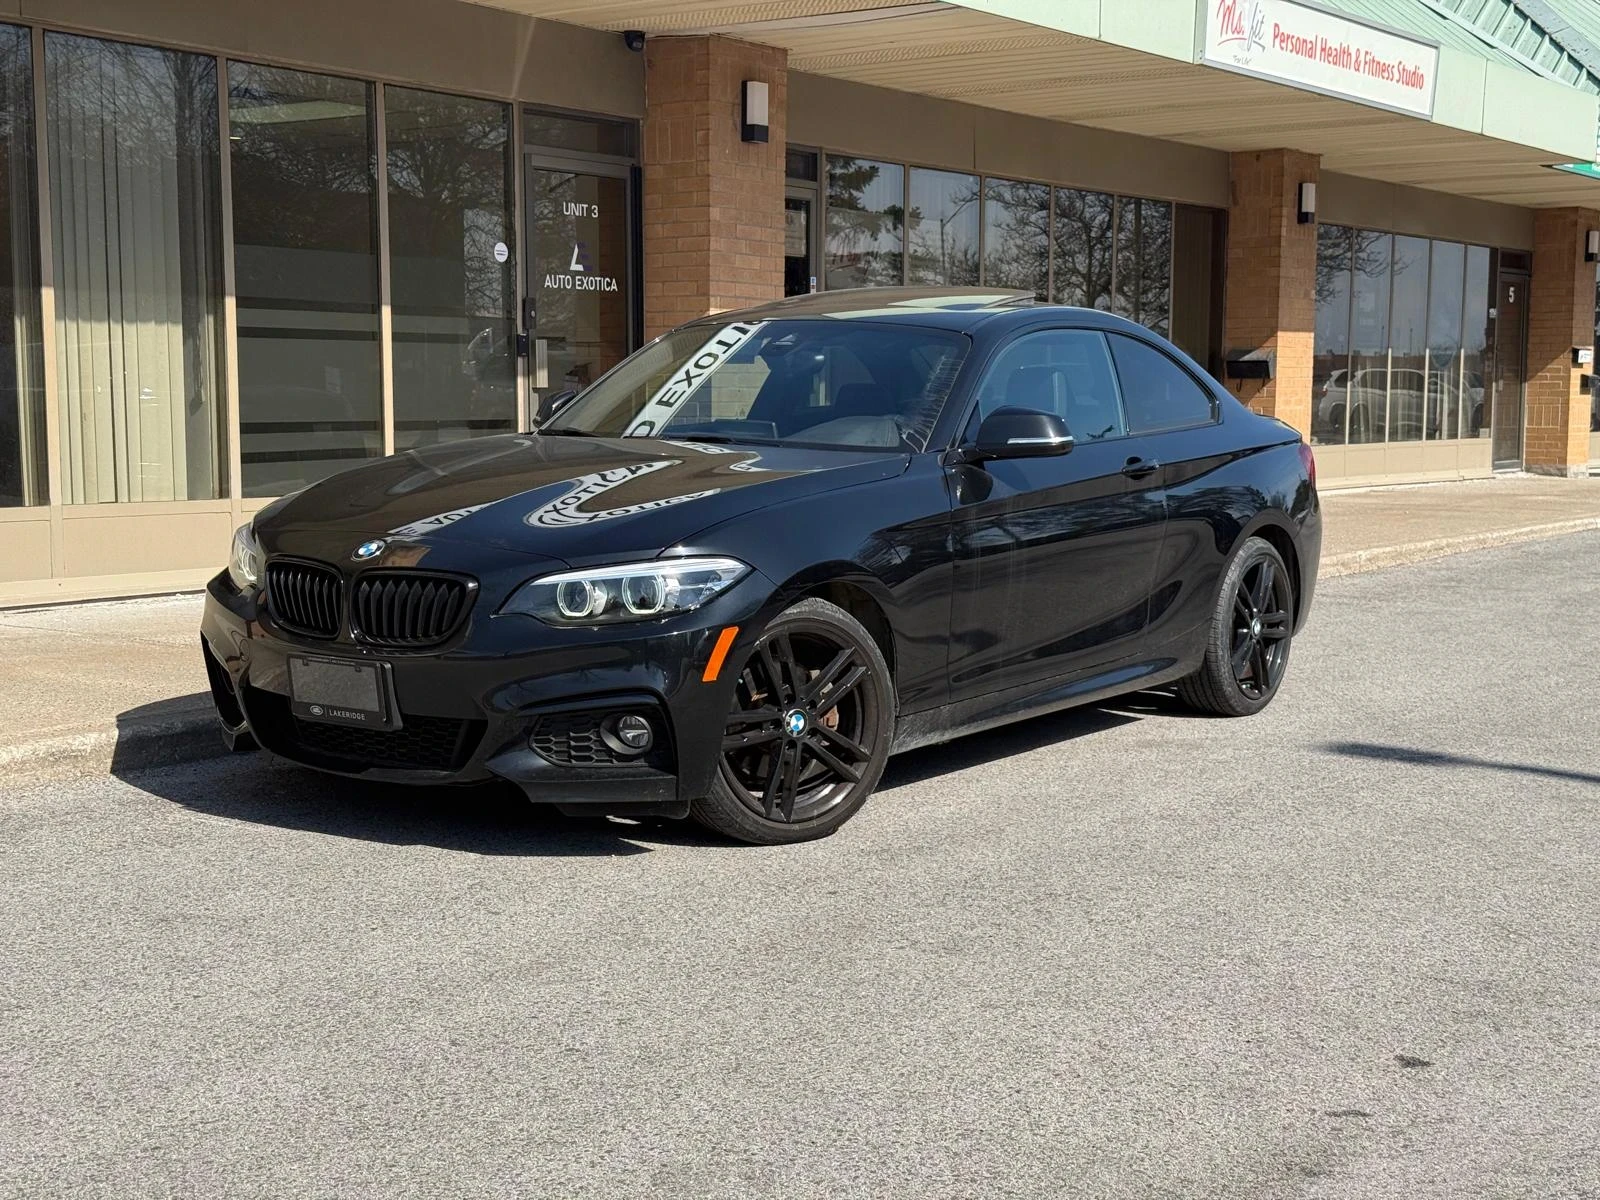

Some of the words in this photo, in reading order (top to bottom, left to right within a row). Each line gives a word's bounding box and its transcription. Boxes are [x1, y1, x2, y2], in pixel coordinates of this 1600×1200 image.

[1272, 22, 1317, 60] Personal
[1319, 37, 1352, 70] Health
[1353, 47, 1361, 72] &
[1363, 50, 1395, 82] Fitness
[1396, 61, 1425, 90] Studio
[563, 201, 588, 216] UNIT
[591, 204, 599, 218] 3
[544, 274, 572, 289] AUTO
[575, 275, 618, 292] EXOTICA
[1508, 286, 1515, 303] 5
[329, 709, 366, 721] LAKERIDGE
